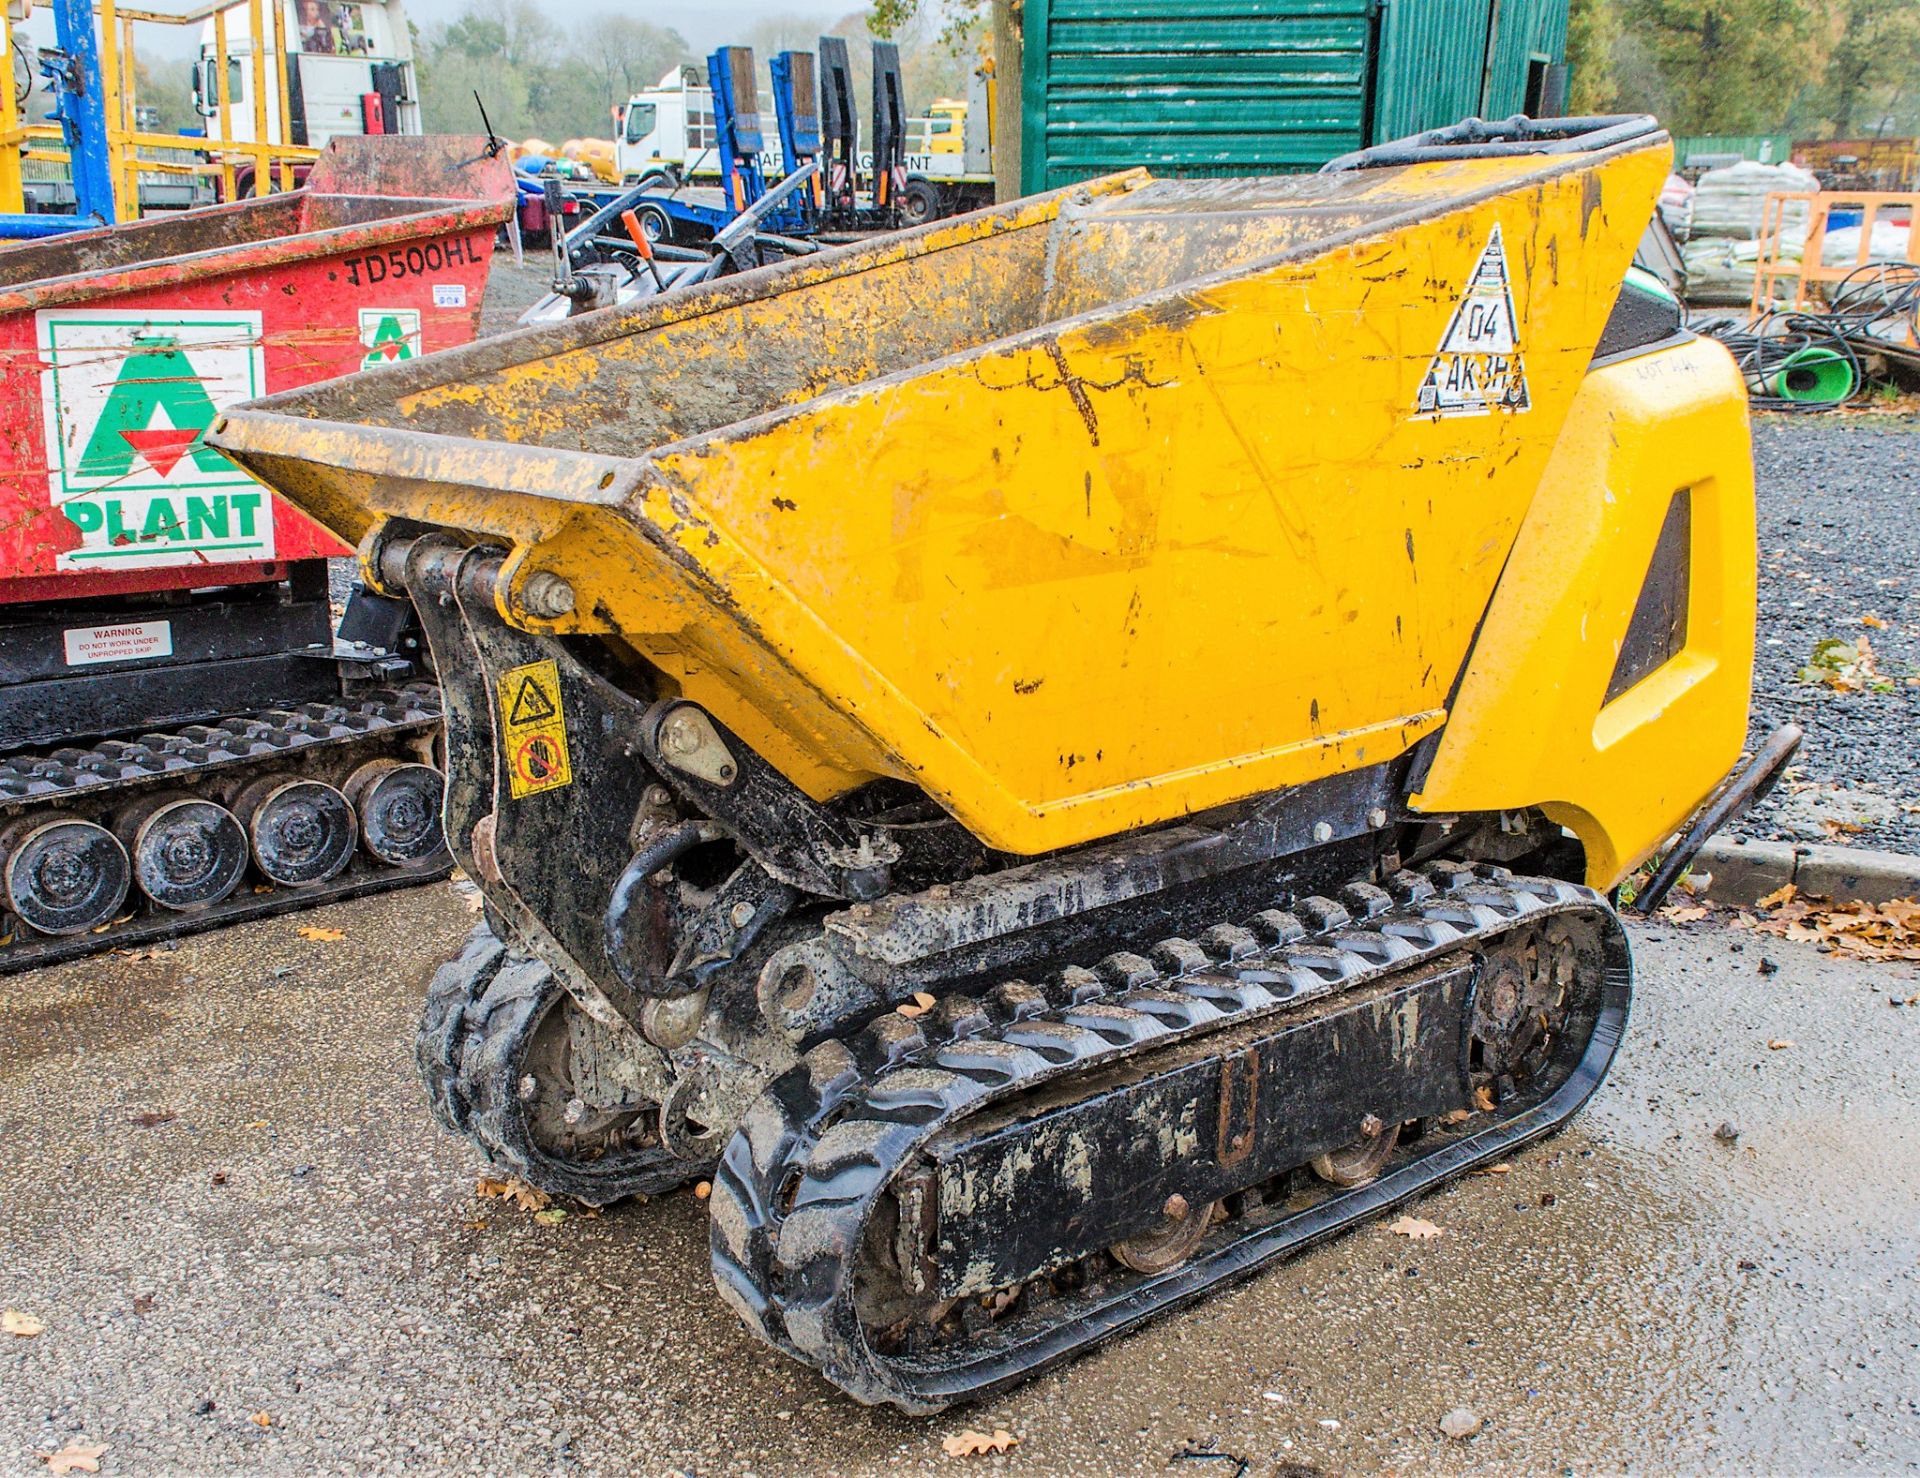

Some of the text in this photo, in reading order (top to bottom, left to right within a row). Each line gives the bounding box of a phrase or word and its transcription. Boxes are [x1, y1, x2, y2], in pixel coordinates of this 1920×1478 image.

[1468, 303, 1499, 341] 04
[64, 493, 261, 546] PLANT
[94, 627, 143, 639] WARNING
[133, 637, 159, 645] UNDER
[88, 646, 152, 659] UNPROPPED SKIP
